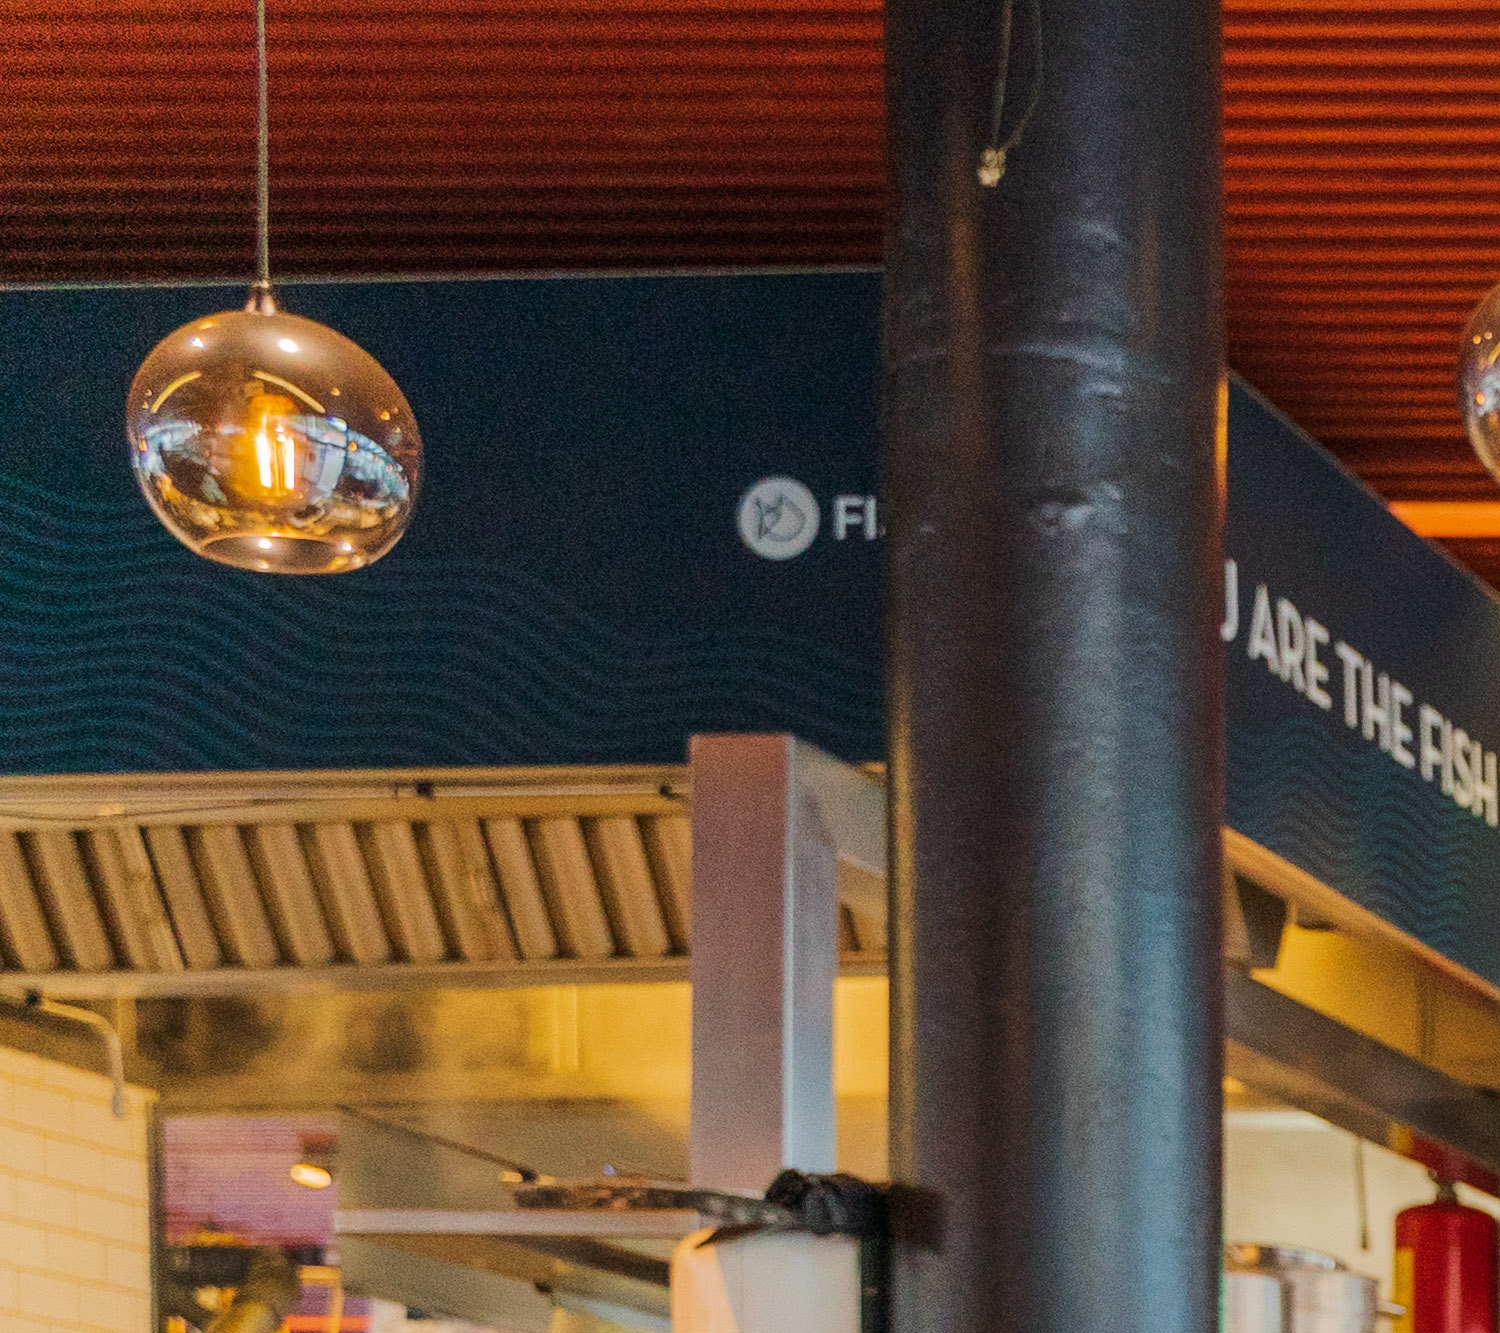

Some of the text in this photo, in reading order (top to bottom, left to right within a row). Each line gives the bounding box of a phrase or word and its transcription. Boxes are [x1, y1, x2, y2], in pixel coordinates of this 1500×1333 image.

[833, 494, 887, 541] FI
[1247, 582, 1333, 710] ARE
[1335, 640, 1416, 768] THE
[1419, 703, 1498, 827] FISH
